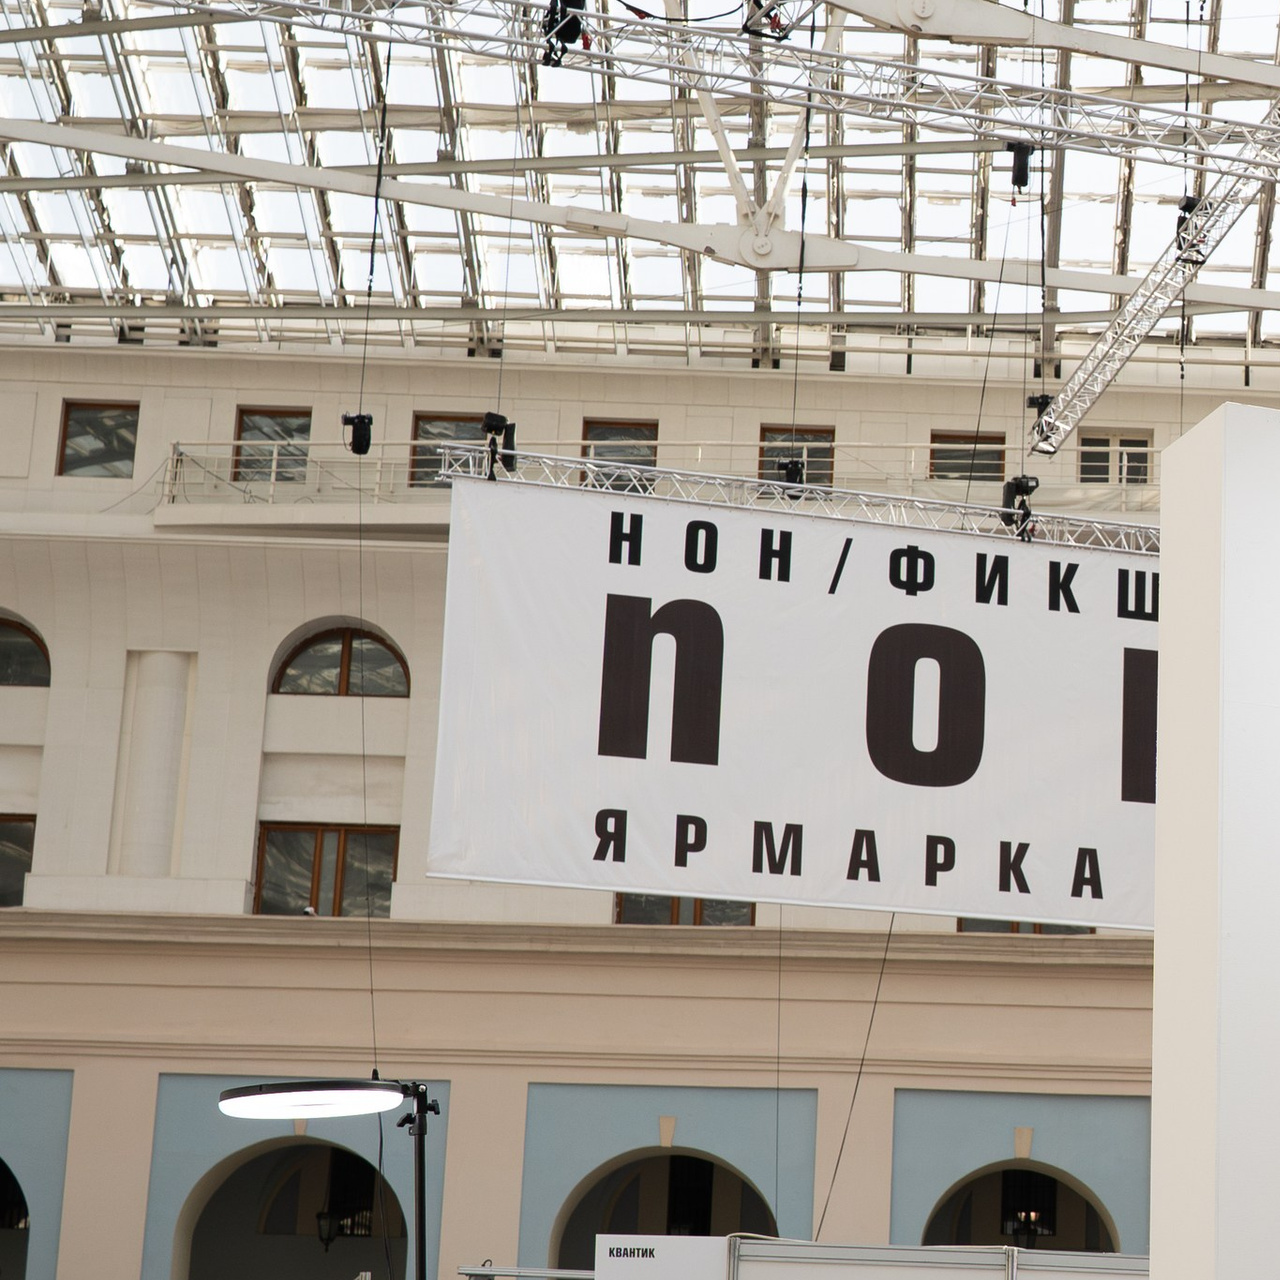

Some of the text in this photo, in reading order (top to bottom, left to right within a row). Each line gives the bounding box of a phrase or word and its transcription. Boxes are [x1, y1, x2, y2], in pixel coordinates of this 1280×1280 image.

[597, 593, 1158, 803] no
[592, 808, 1105, 900] ЯРМАРКА
[608, 1246, 656, 1259] КВАНТИК
